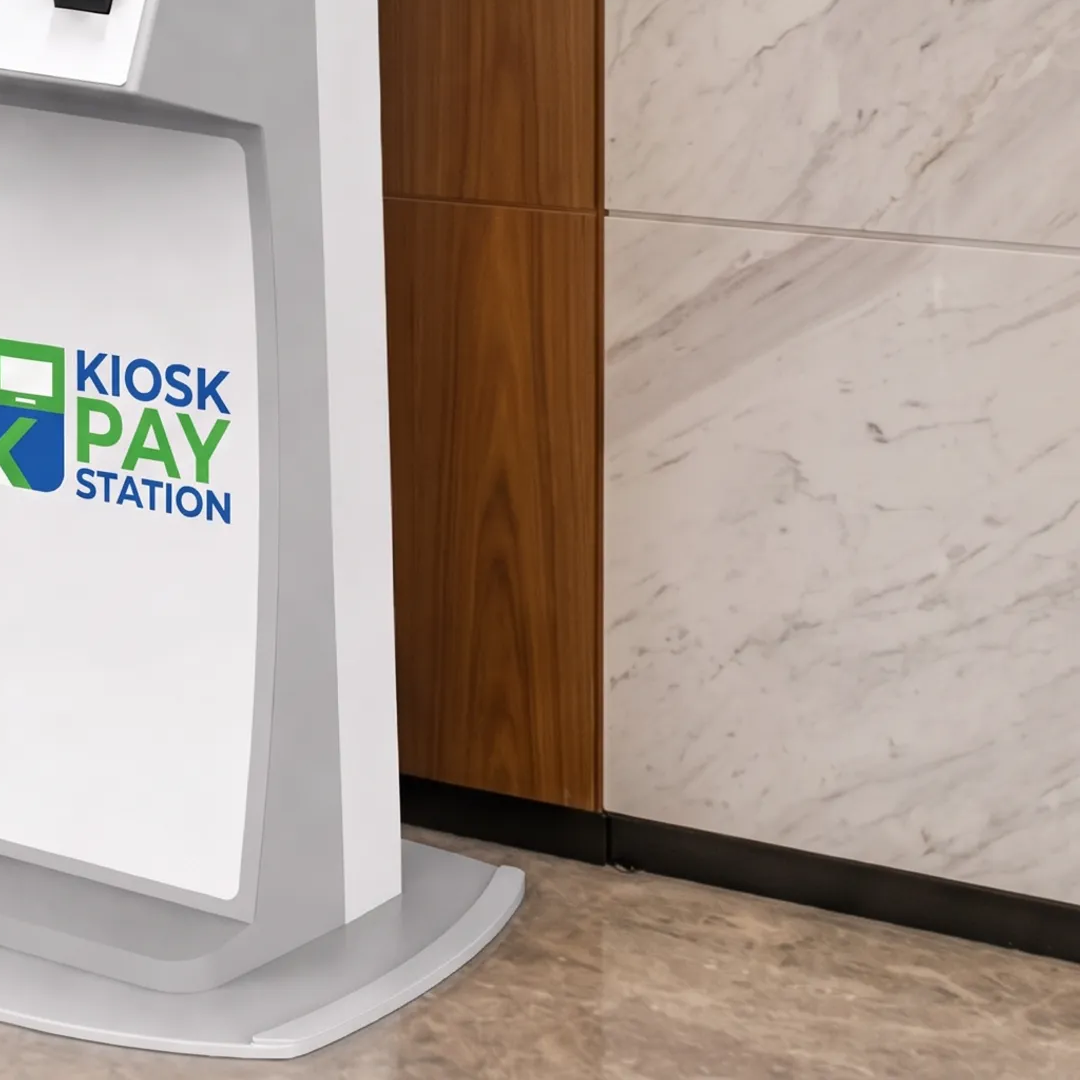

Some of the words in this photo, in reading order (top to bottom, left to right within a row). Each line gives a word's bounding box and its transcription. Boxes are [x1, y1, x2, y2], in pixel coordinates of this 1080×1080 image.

[76, 349, 231, 415] KIOSK
[76, 396, 231, 484] PAY
[76, 467, 231, 525] STATION
